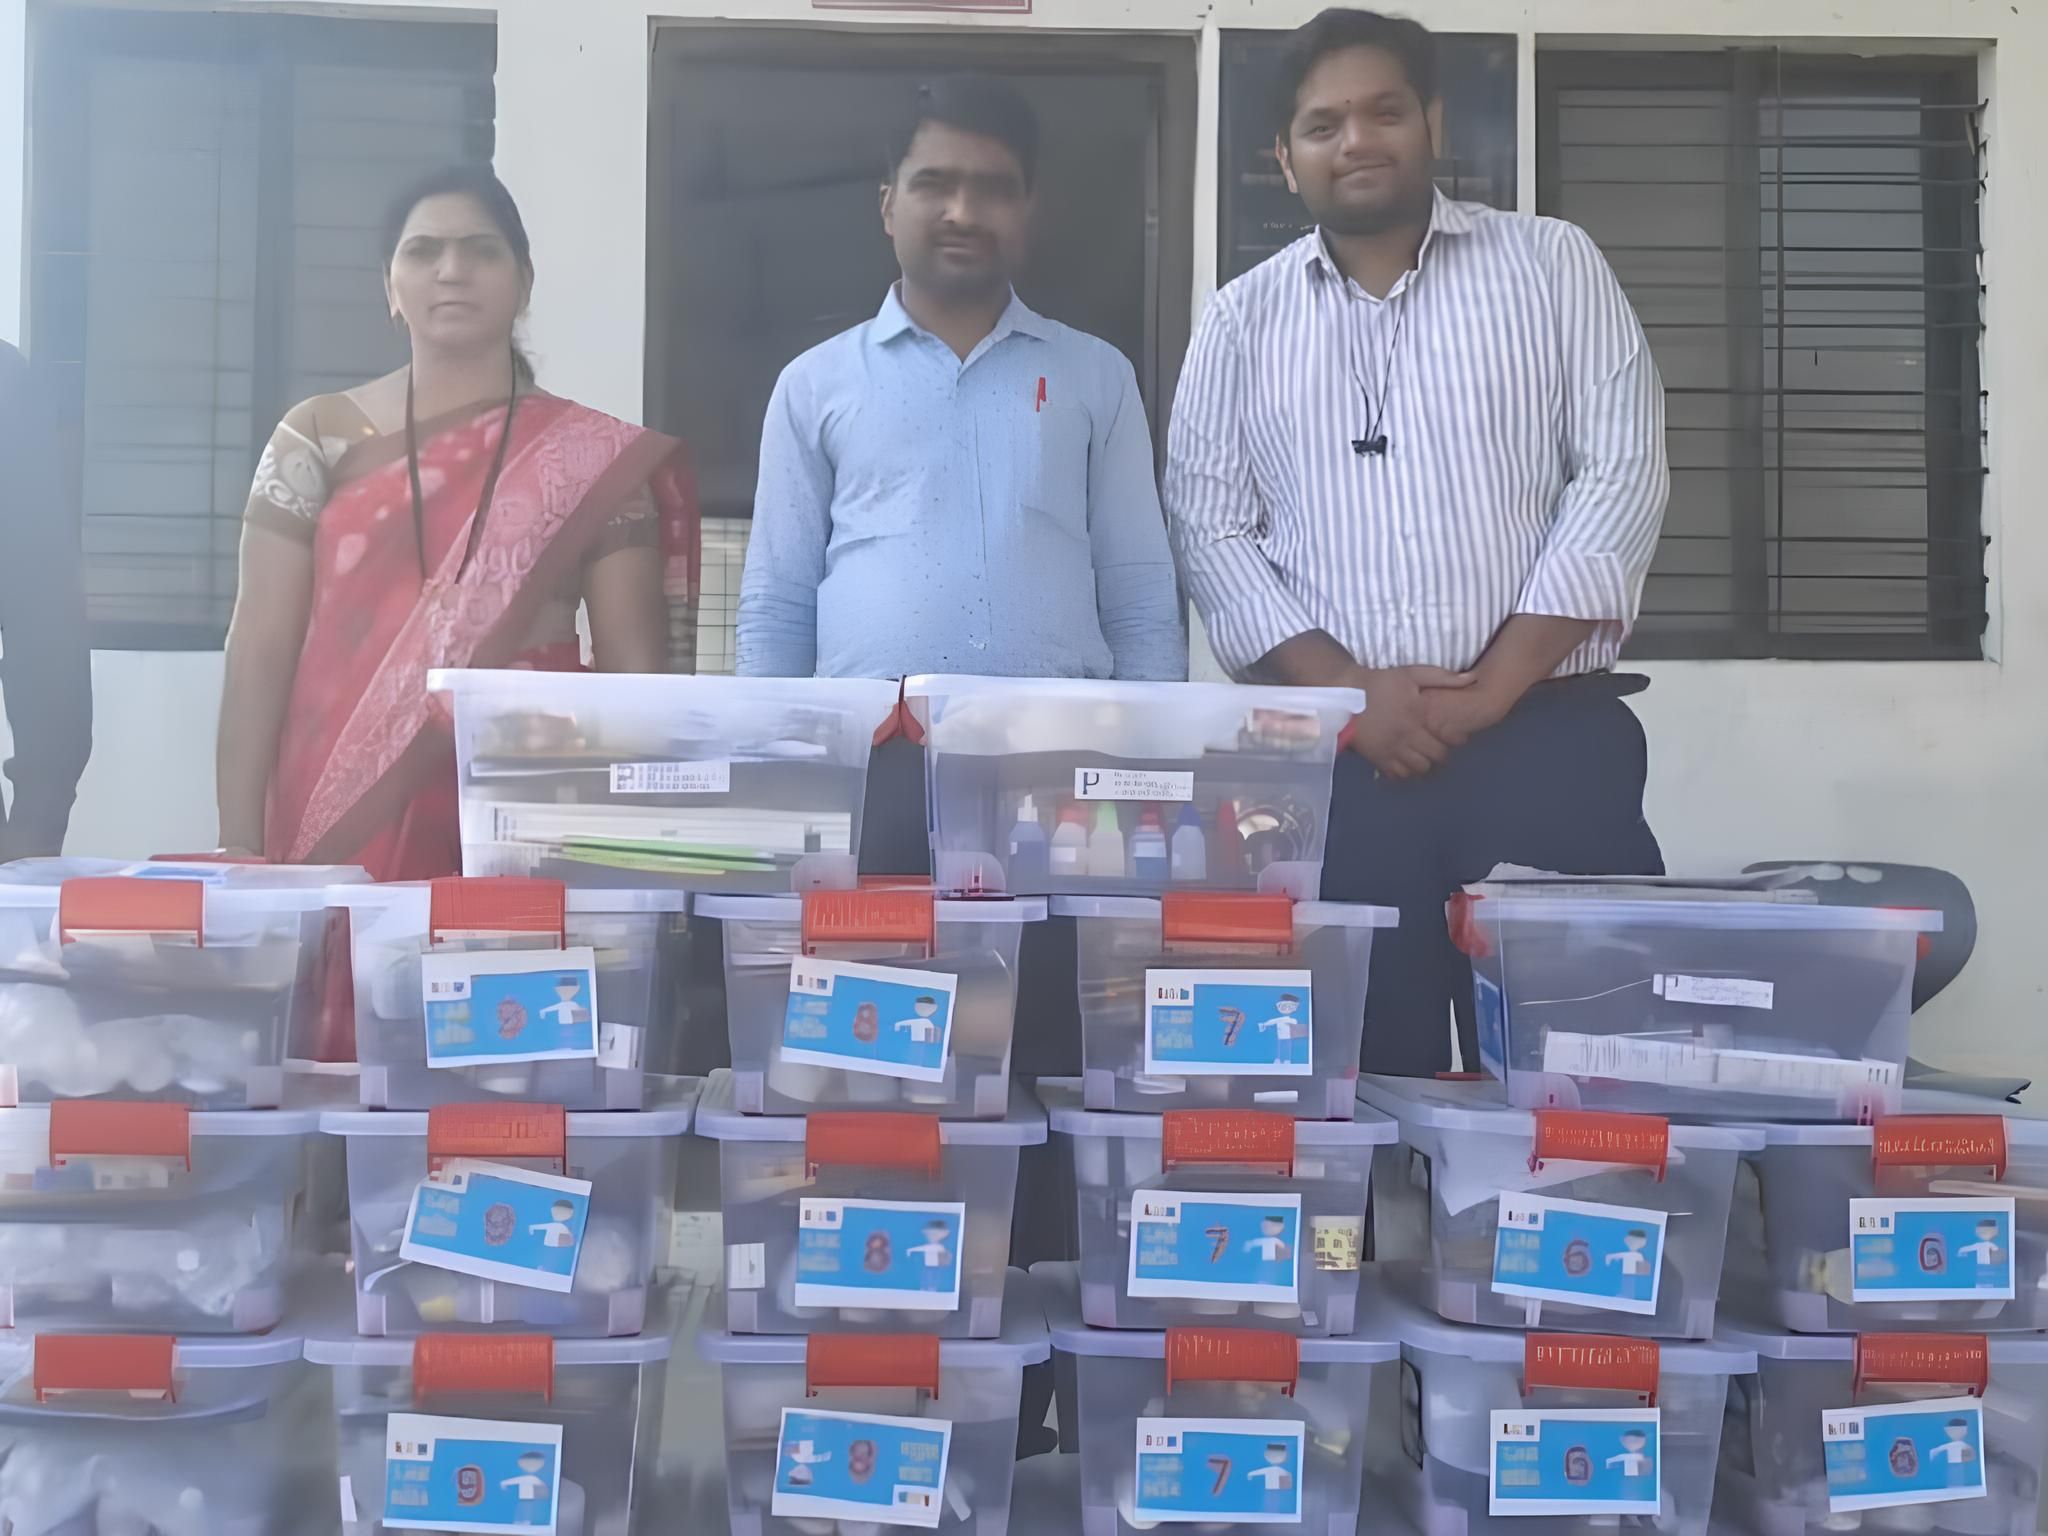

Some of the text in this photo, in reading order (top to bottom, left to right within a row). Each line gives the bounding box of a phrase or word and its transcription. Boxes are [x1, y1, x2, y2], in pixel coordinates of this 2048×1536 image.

[1217, 1006, 1245, 1046] 7
[864, 1231, 891, 1273] 8
[1204, 1224, 1228, 1263] 7
[1563, 1240, 1590, 1276] 6
[1208, 1455, 1232, 1496] 7
[1565, 1446, 1592, 1486] 6
